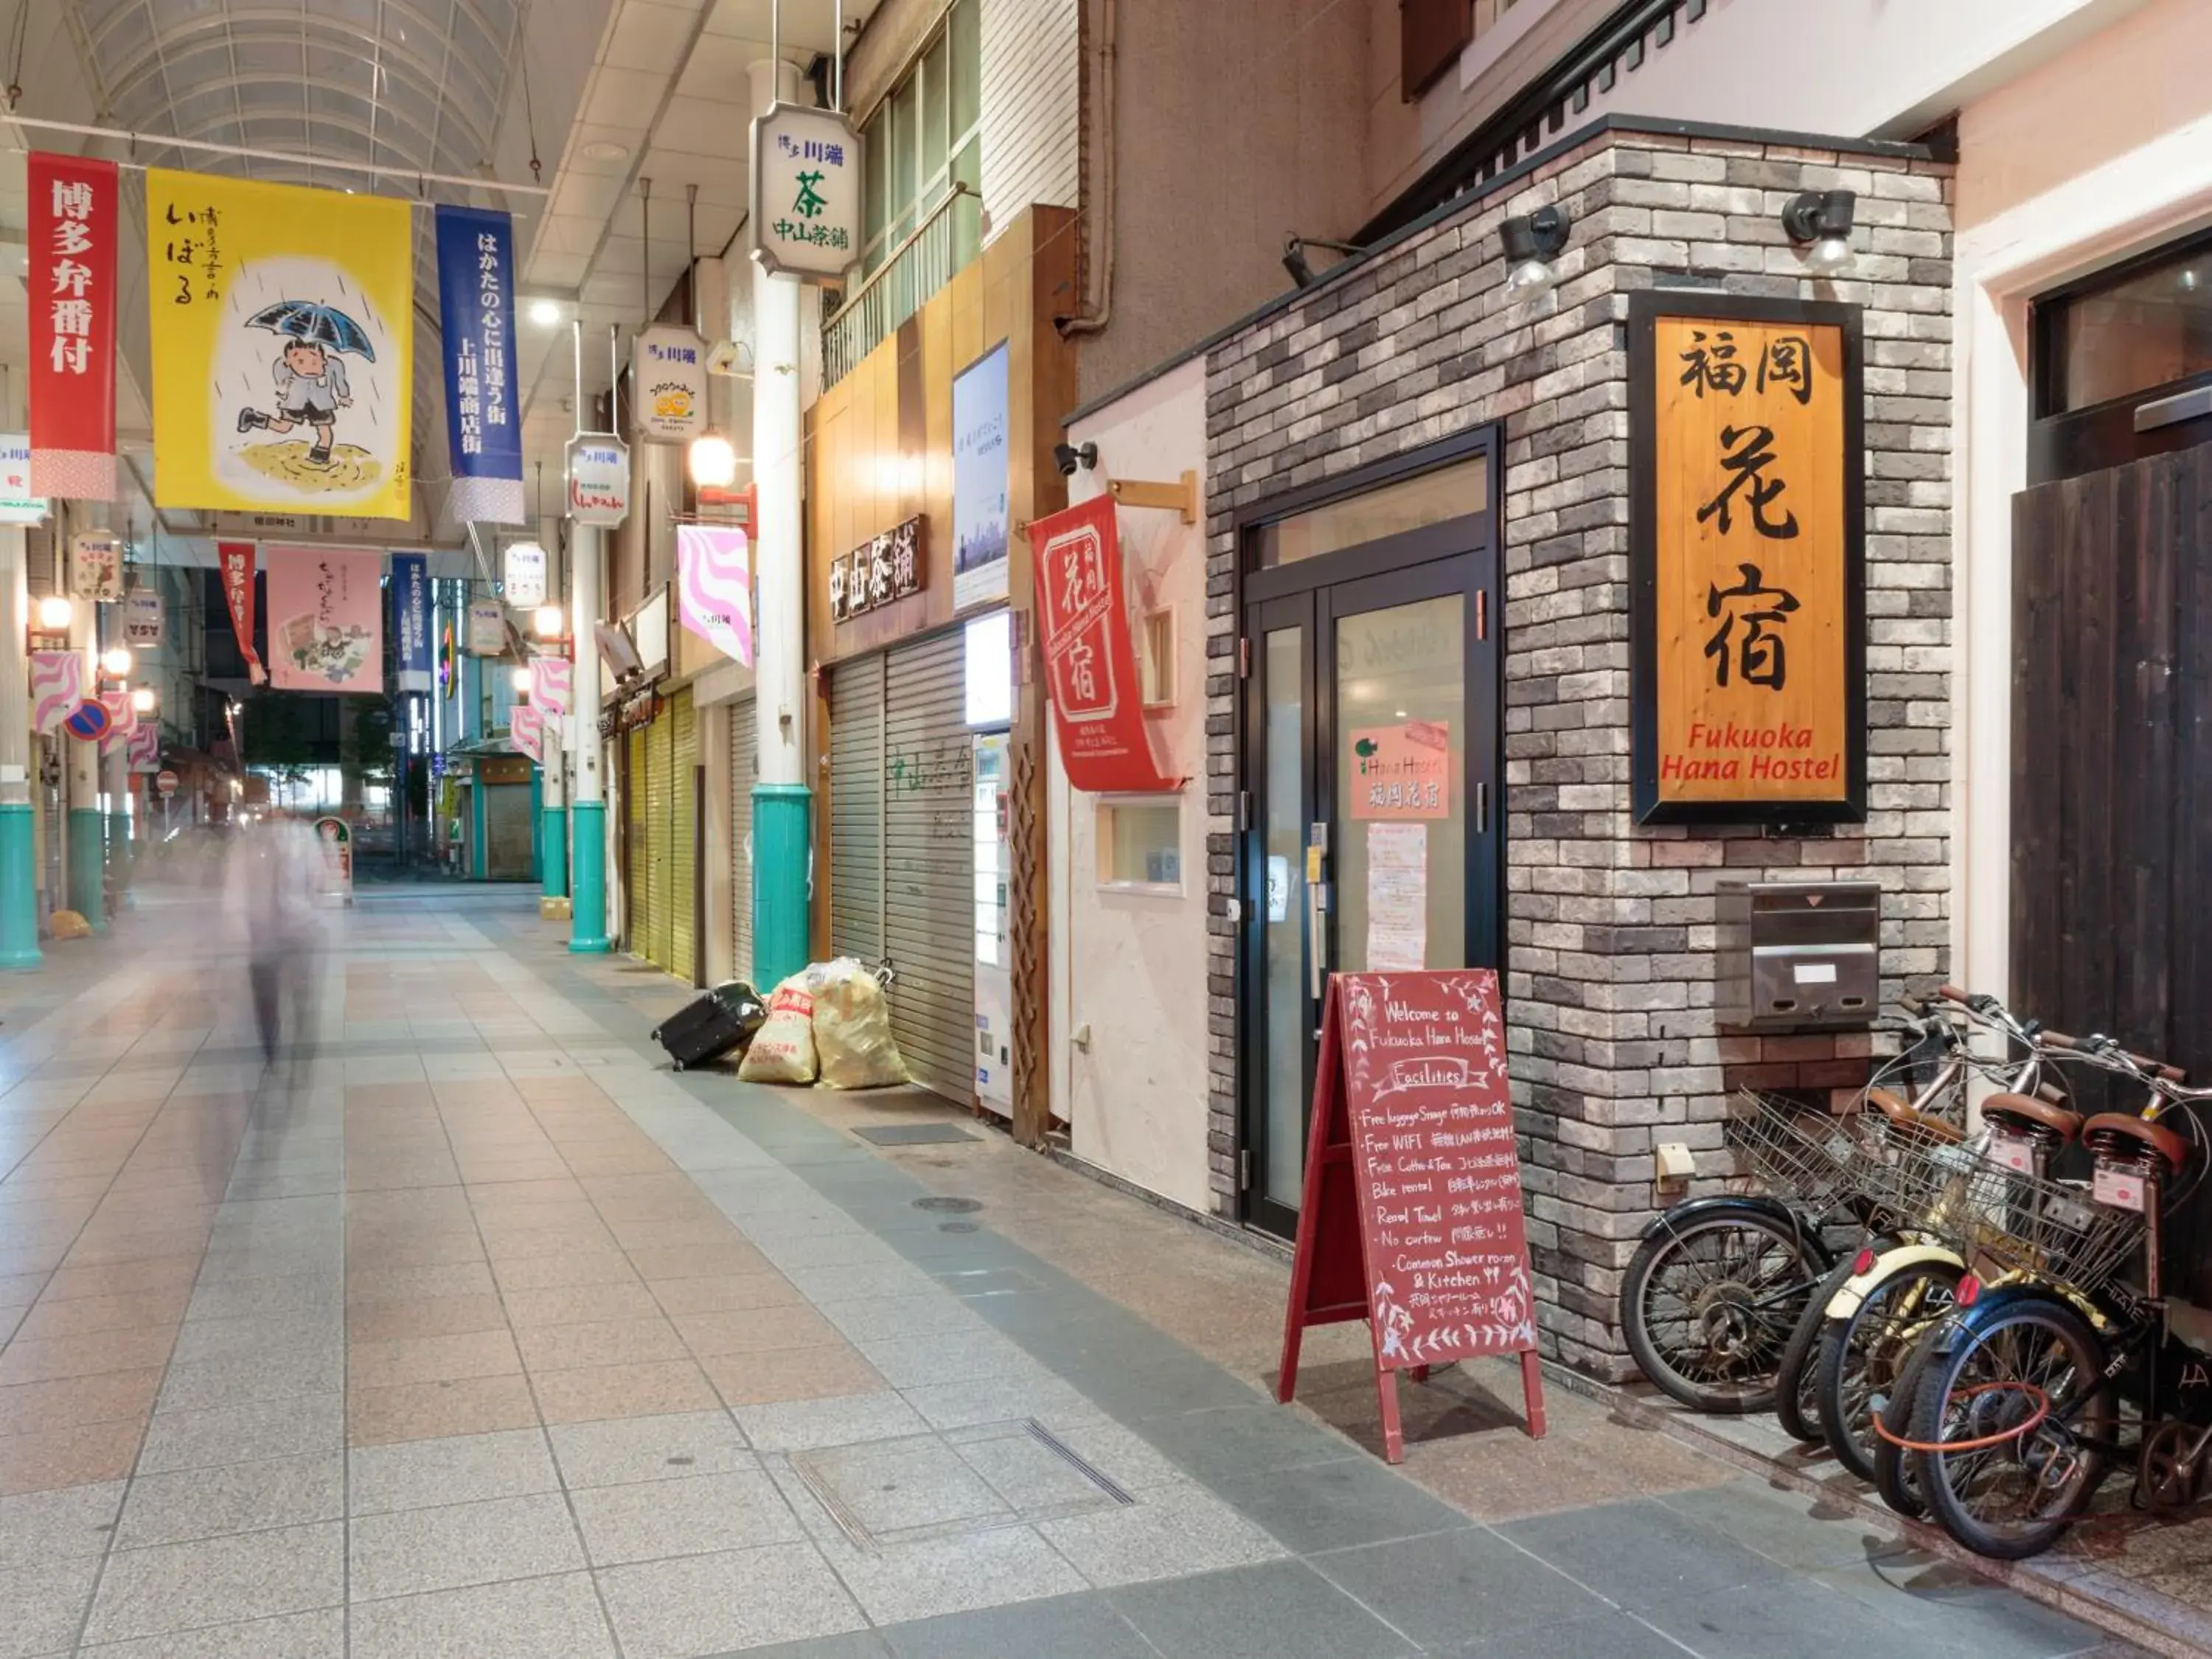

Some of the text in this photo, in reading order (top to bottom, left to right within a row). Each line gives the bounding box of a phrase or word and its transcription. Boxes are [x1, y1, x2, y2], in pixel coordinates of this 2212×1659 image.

[778, 133, 844, 167] 博多川端
[791, 170, 829, 218] 茶
[772, 218, 849, 251] 中山茶舗
[163, 202, 205, 305] いぼる
[50, 179, 94, 375] 博多弁番付
[478, 232, 507, 425] はかたの心に出逢う街
[1679, 330, 1813, 405] 福岡
[457, 337, 482, 455] 上川端商店街
[829, 521, 916, 619] 中山茶舗
[1697, 424, 1801, 692] 花宿
[1688, 723, 1813, 749] Fukuoka
[1660, 754, 1840, 782] Hana Hostel
[1384, 1001, 1459, 1023] Welcome to
[1368, 1028, 1425, 1048] Fukuoka
[1394, 1062, 1461, 1086] Facilities
[1362, 1108, 1385, 1127] Free
[1364, 1133, 1388, 1153] Free
[1368, 1155, 1393, 1178] Free
[1372, 1181, 1397, 1200] Bike
[1402, 1178, 1433, 1194] rental
[1381, 1230, 1399, 1246] No
[1396, 1250, 1516, 1272] Common Shower room
[1413, 1270, 1481, 1290] & Kitchen
